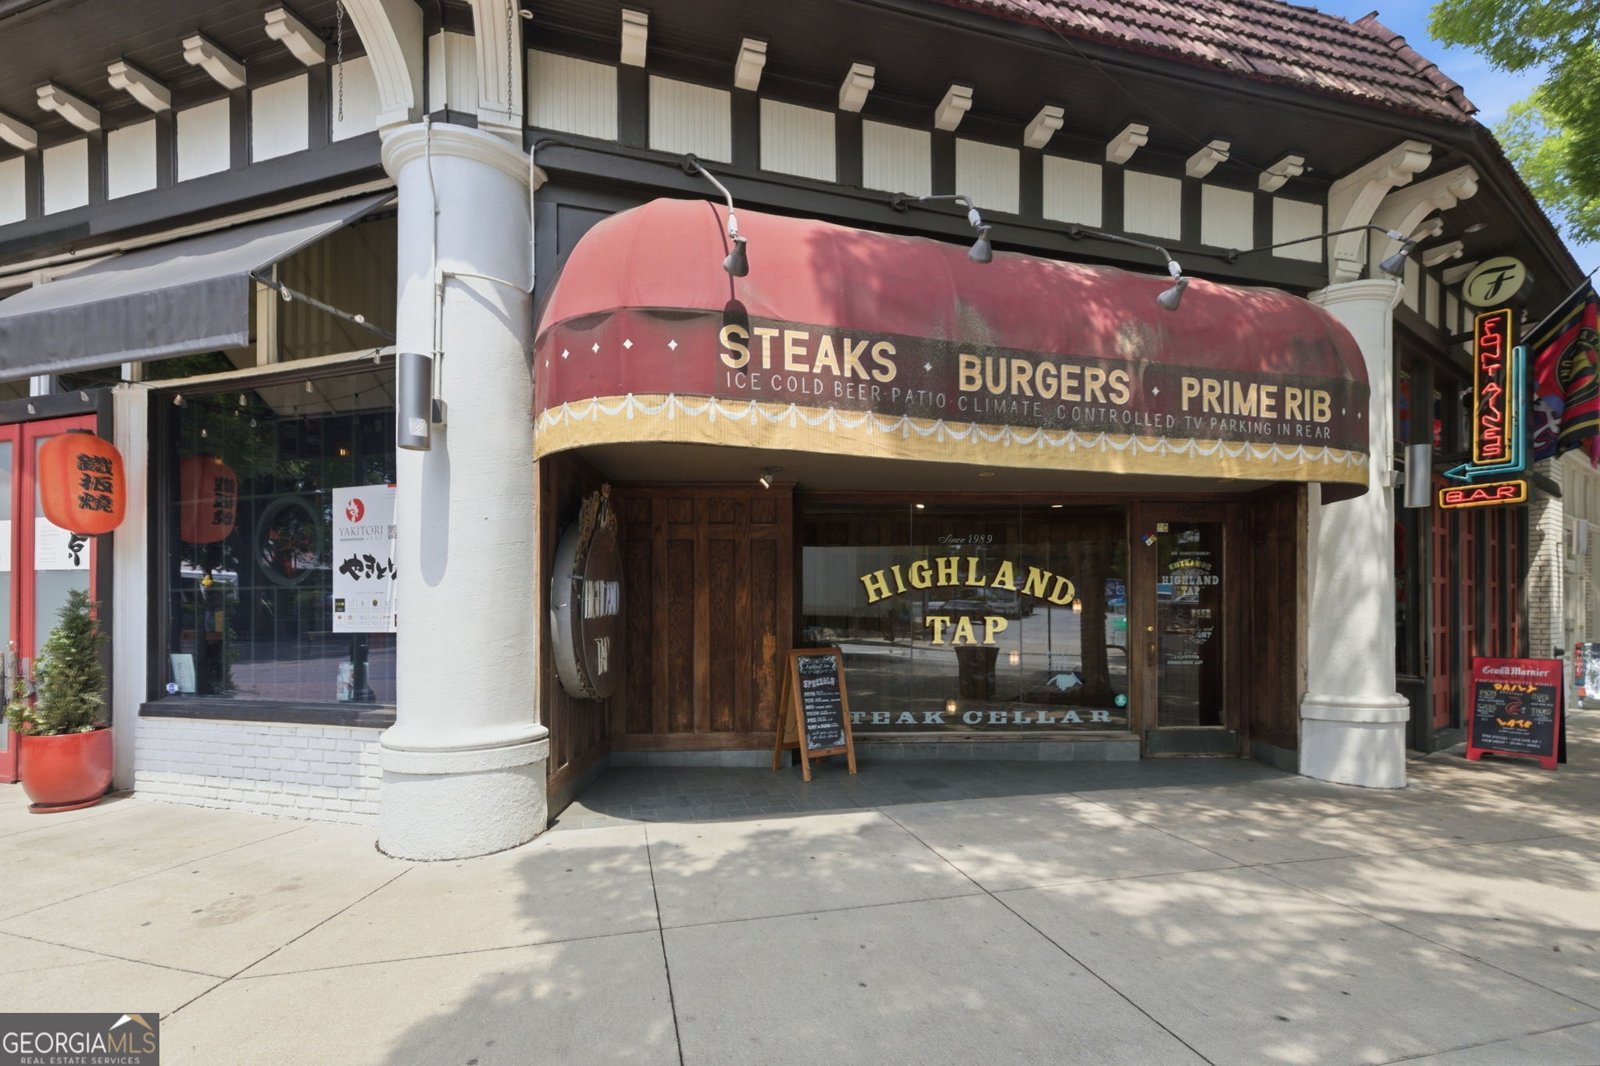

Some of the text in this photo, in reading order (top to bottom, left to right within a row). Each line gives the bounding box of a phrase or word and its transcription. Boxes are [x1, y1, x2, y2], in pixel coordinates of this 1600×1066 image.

[1468, 264, 1517, 300] F
[719, 324, 897, 383] STEAKS
[959, 353, 1130, 405] BURGERS
[726, 371, 1331, 440] ICE COLD BEER PATIO CLIMATE CONTROLLED TV PARKING IN REAR
[1181, 376, 1331, 423] PRIME RIB
[1446, 486, 1517, 503] BAR
[339, 525, 384, 536] YAKITORI
[938, 534, 993, 544] Since 1989
[860, 556, 1076, 605] HIGHLAND
[1161, 575, 1219, 585] HIGHLAND
[925, 615, 1009, 645] TAP
[1482, 665, 1551, 677] Grand Marnier
[1493, 683, 1537, 694] DAILY
[850, 711, 947, 725] TEAK
[962, 710, 1112, 725] CELLAR
